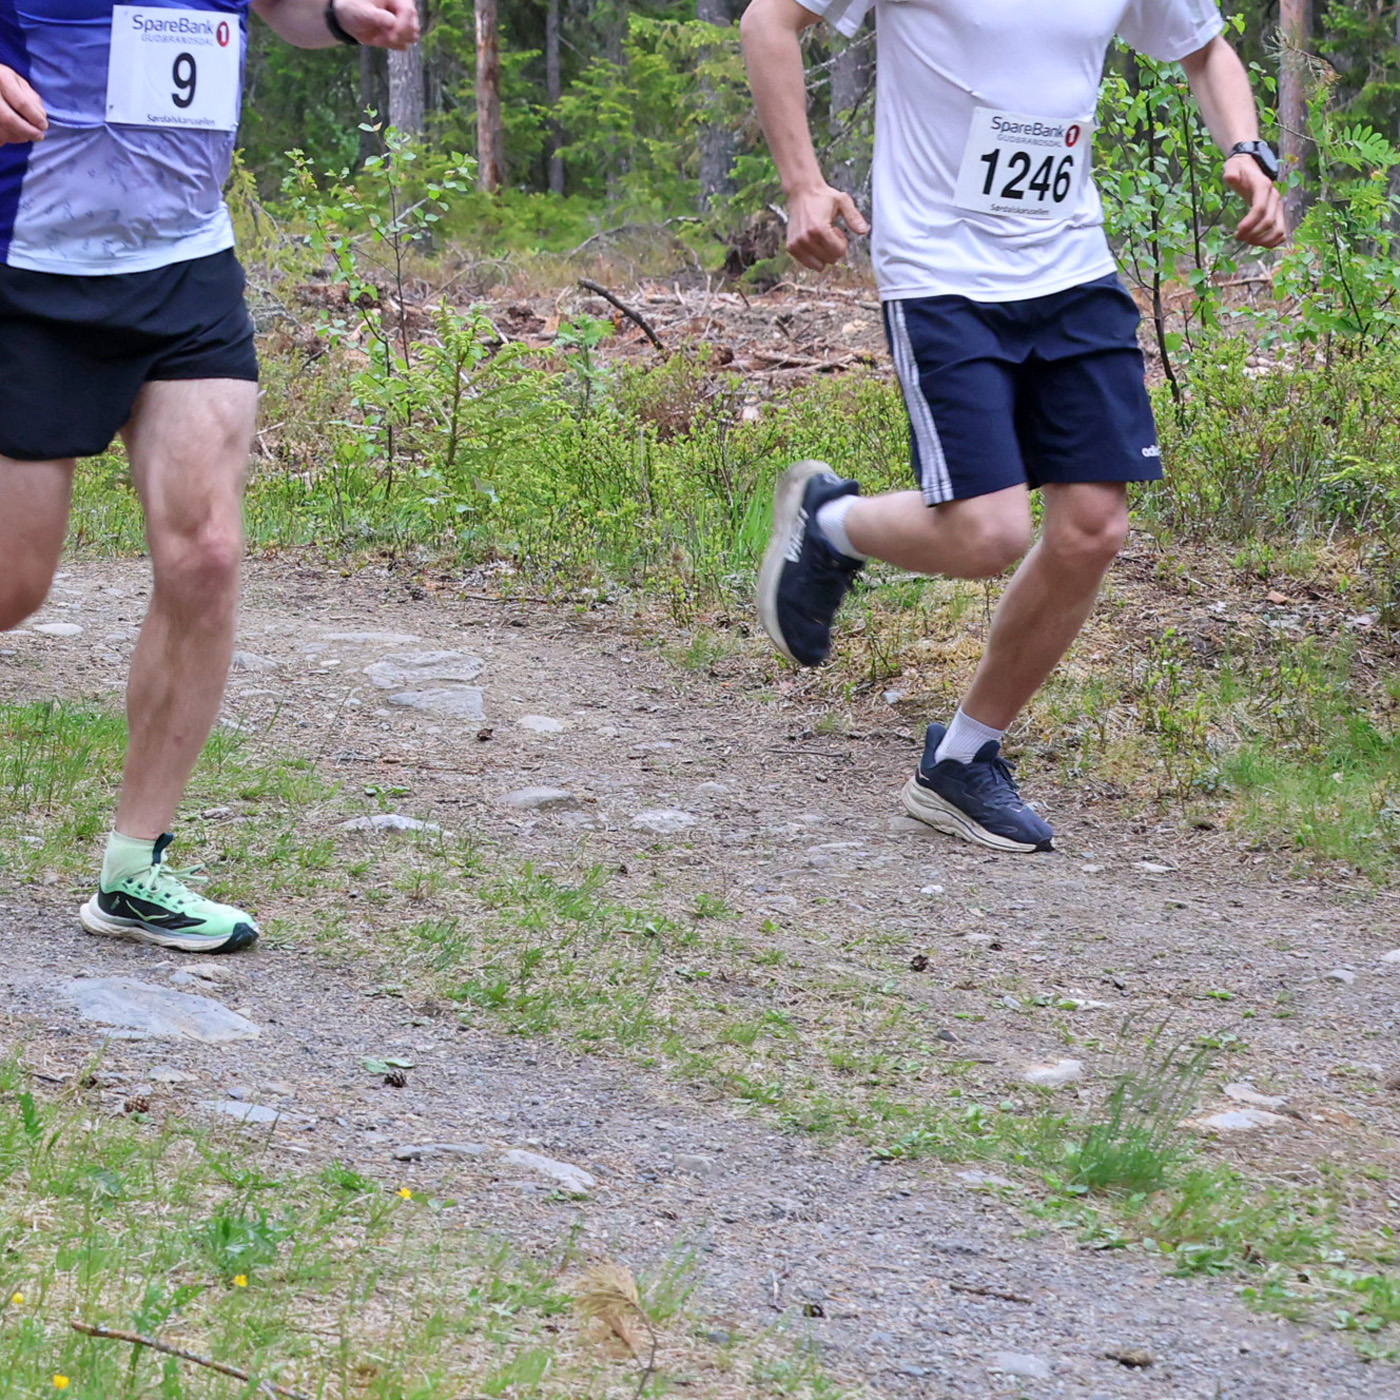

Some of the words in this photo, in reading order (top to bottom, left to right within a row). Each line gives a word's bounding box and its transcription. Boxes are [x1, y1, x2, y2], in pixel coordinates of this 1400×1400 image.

[132, 13, 215, 35] SpareBank
[171, 52, 197, 109] 9
[990, 115, 1065, 138] SpareBank
[980, 148, 1075, 203] 1246
